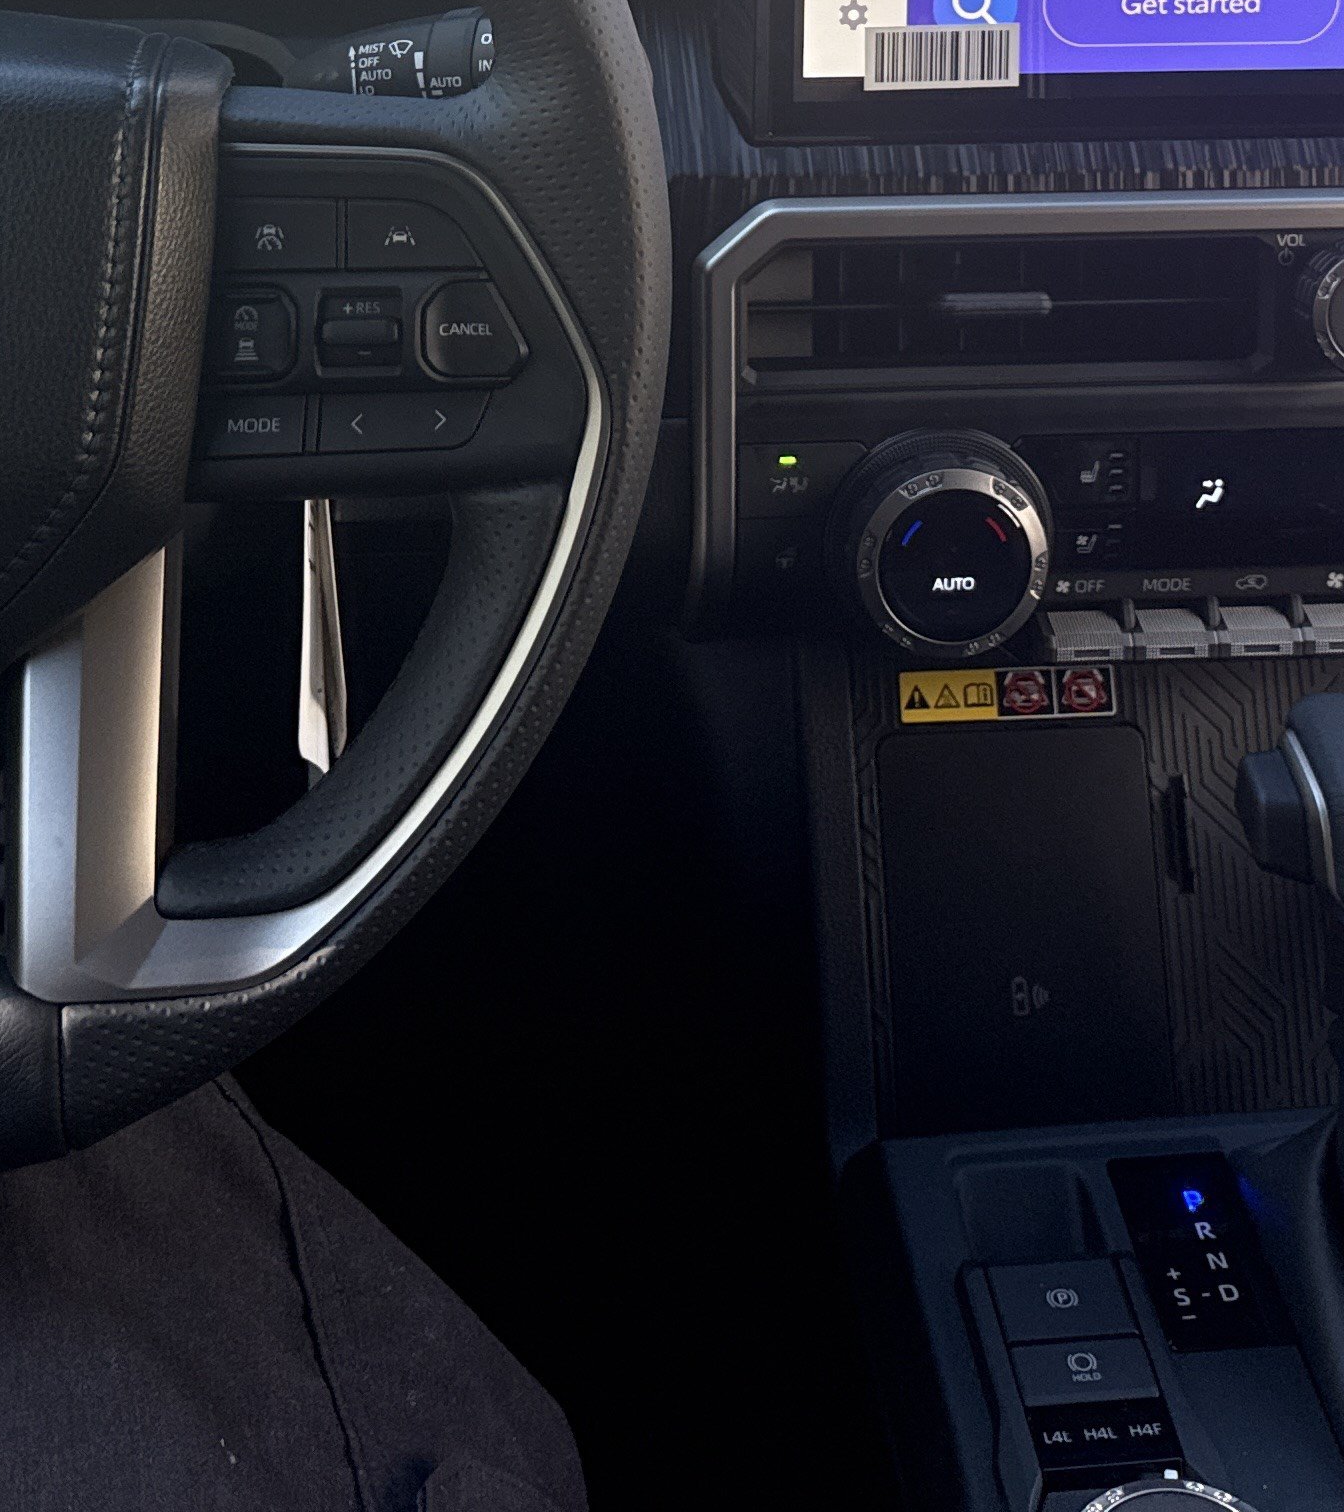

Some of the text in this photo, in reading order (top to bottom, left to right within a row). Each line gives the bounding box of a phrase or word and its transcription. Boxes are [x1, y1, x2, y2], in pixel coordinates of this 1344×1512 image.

[358, 42, 386, 54] MIST
[358, 57, 380, 69] OFF
[359, 69, 392, 81] AUTO
[429, 76, 462, 88] AUTO
[1277, 233, 1305, 247] VOL
[439, 323, 493, 337] CANCEL
[227, 418, 281, 433] MODE
[932, 577, 975, 592] AUTO
[1075, 579, 1105, 593] OFF
[1143, 577, 1191, 592] MODE
[1183, 1190, 1205, 1213] P
[1194, 1221, 1217, 1240] R
[1205, 1252, 1229, 1270] N
[1173, 1284, 1239, 1306] S D
[1072, 1372, 1102, 1382] HOLD
[1128, 1423, 1162, 1437] H4F
